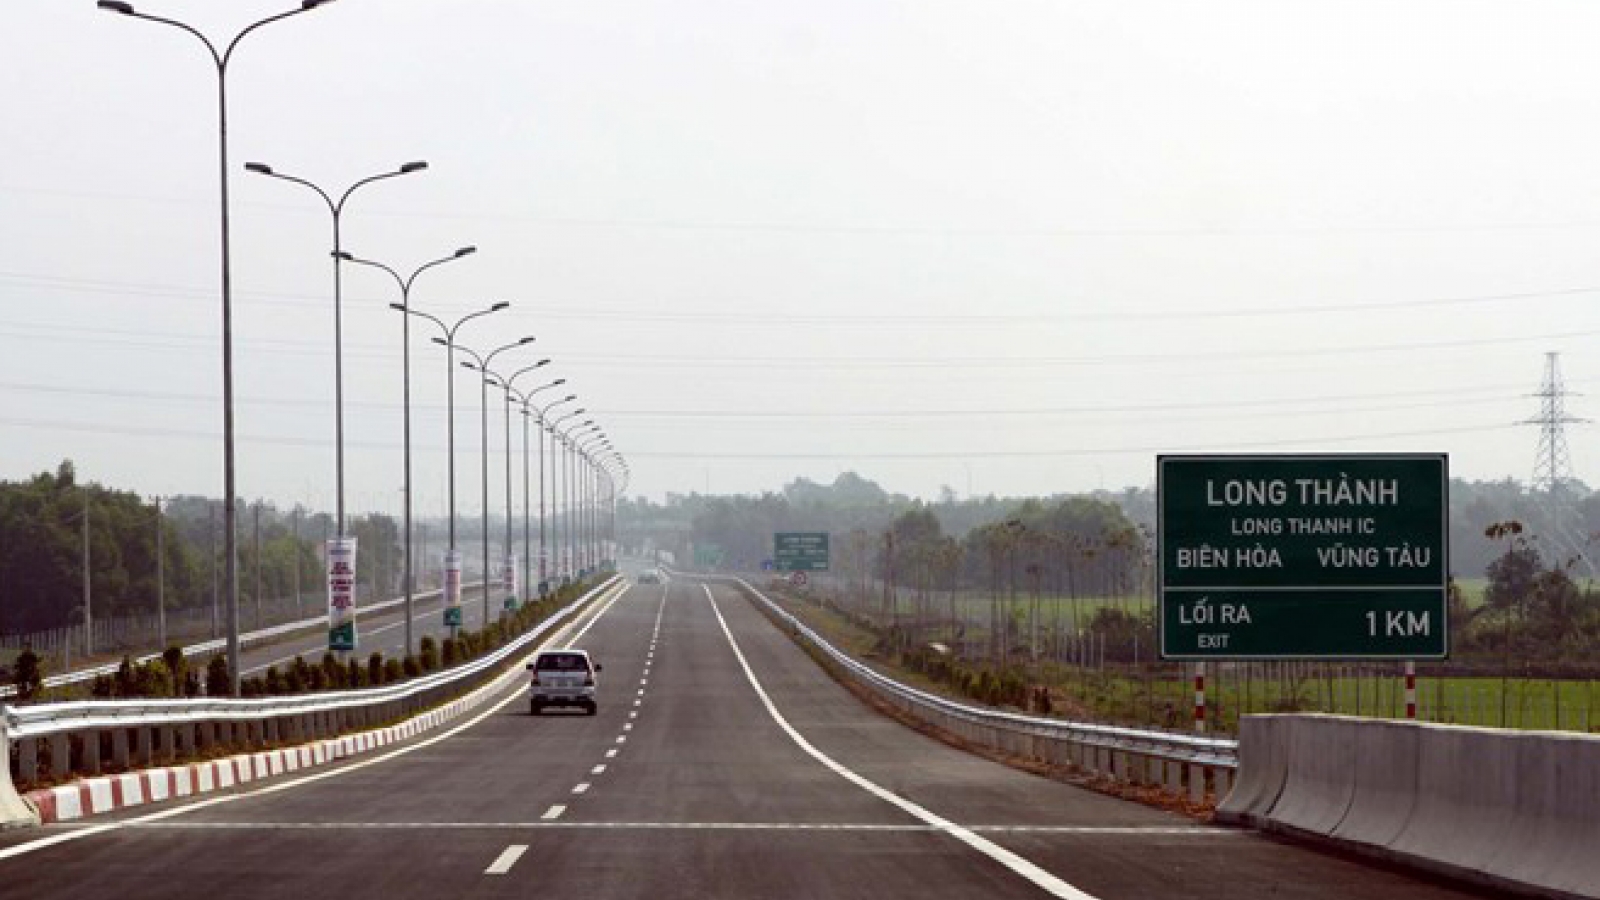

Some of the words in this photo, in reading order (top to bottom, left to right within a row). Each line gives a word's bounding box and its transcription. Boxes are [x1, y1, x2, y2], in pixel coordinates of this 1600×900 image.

[1207, 479, 1287, 506] LONG
[1295, 472, 1398, 506] THÀNH
[1231, 518, 1282, 535] LONG
[1288, 518, 1352, 534] THANH
[1358, 518, 1375, 534] IC
[1177, 543, 1228, 568] BIÊN
[1236, 543, 1282, 568] HÒA
[1317, 543, 1379, 568] VŨNG
[1384, 542, 1430, 568] TÀU
[1179, 596, 1214, 624] LỐI
[1221, 604, 1252, 624] RA
[1366, 611, 1377, 636] 1
[1385, 611, 1431, 636] KM
[1198, 633, 1230, 648] EXIT
